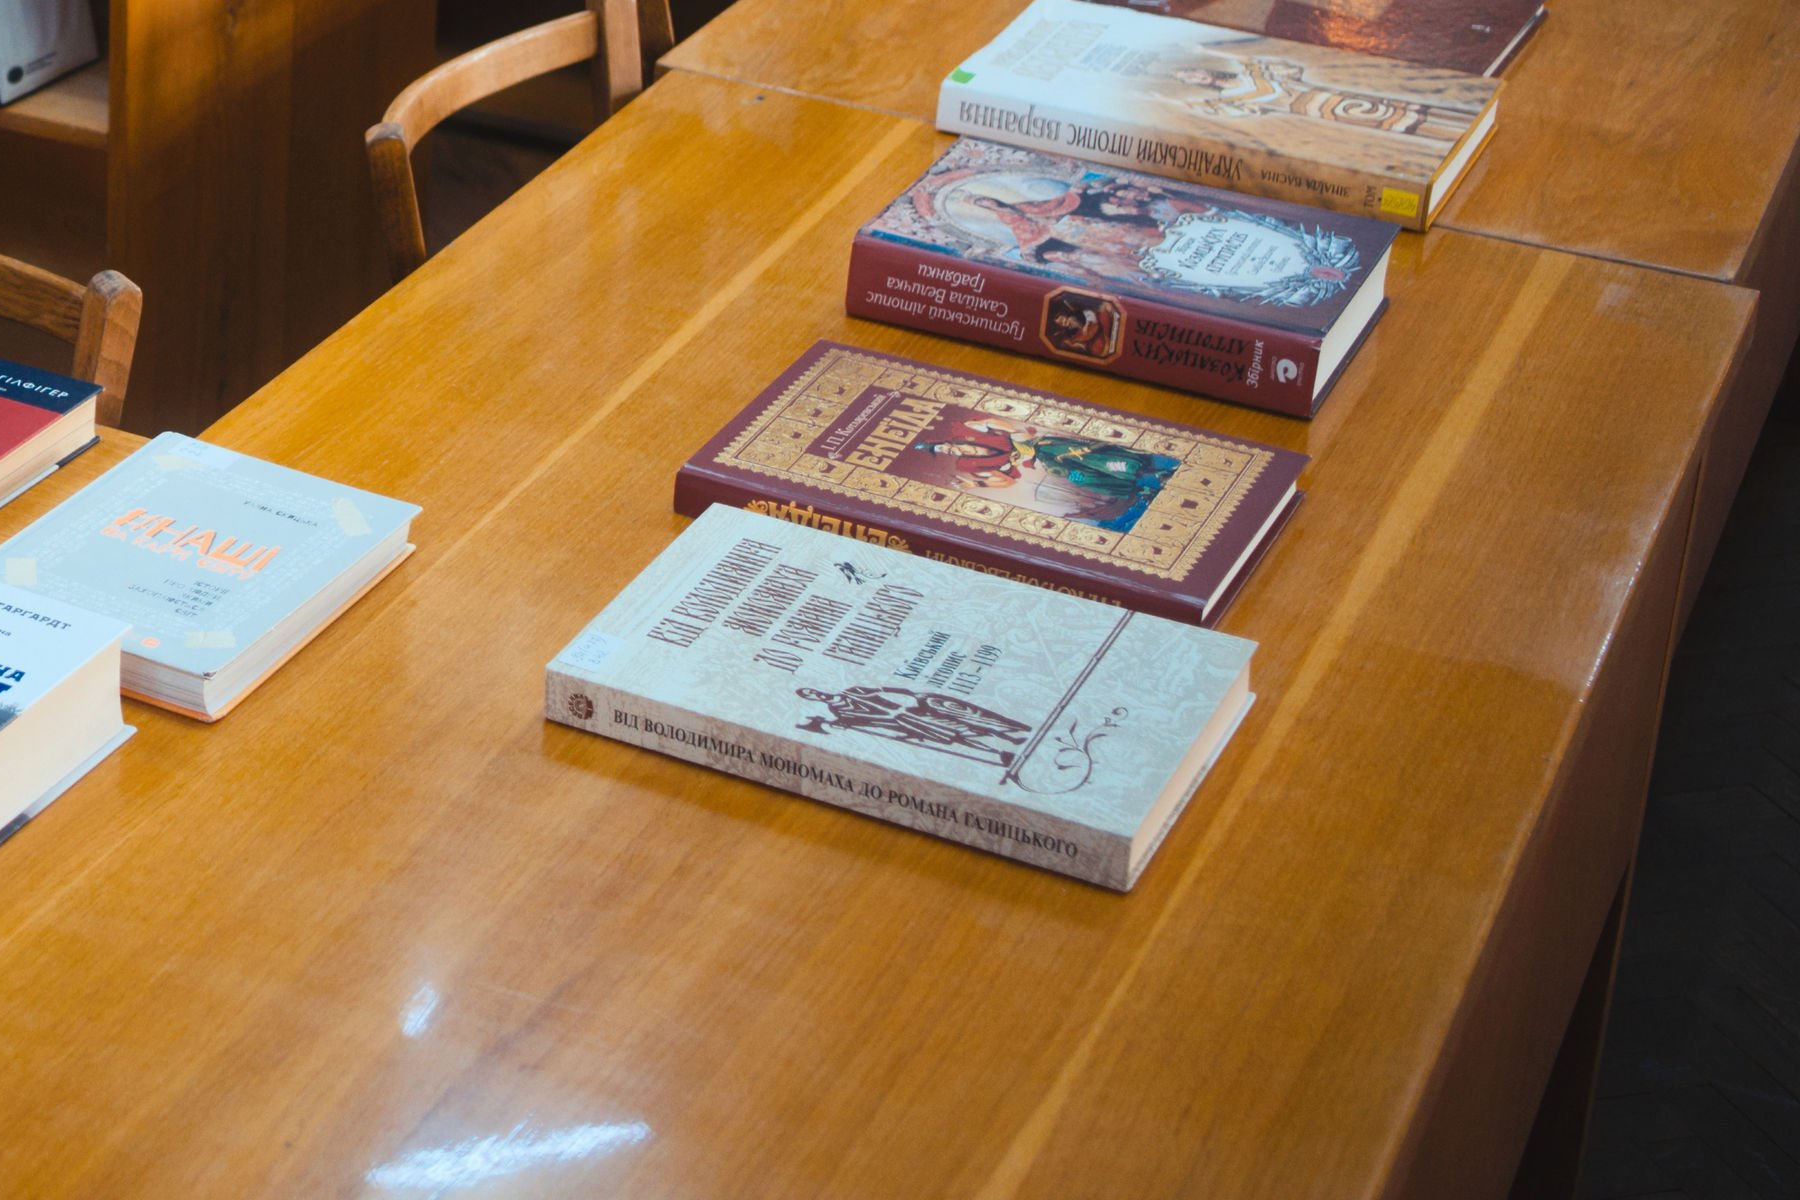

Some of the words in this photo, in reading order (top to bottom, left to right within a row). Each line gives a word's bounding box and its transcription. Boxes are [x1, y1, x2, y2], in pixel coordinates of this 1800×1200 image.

[1067, 124, 1130, 157] ЛІТОПИС
[1136, 136, 1244, 181] УКРАЇНСЬКИЙ
[886, 276, 945, 304] Величка
[917, 262, 987, 293] Грабянки
[865, 291, 923, 320] літопис
[924, 304, 1026, 341] Густинський
[946, 292, 1009, 318] Самійла
[1245, 339, 1265, 389] Збірник
[844, 396, 947, 471] ЕНЕЇДА
[752, 646, 803, 675] ДО
[893, 628, 951, 681] Київський
[924, 649, 967, 689] літопис
[613, 709, 640, 732] ВІД
[643, 718, 755, 766] ВОЛОДИМИРА
[759, 754, 855, 795] МОНОМАХА
[859, 779, 884, 801] ДО
[887, 789, 959, 825] РОМАНА
[963, 811, 1080, 859] ГАЛИЦЬКОГО
